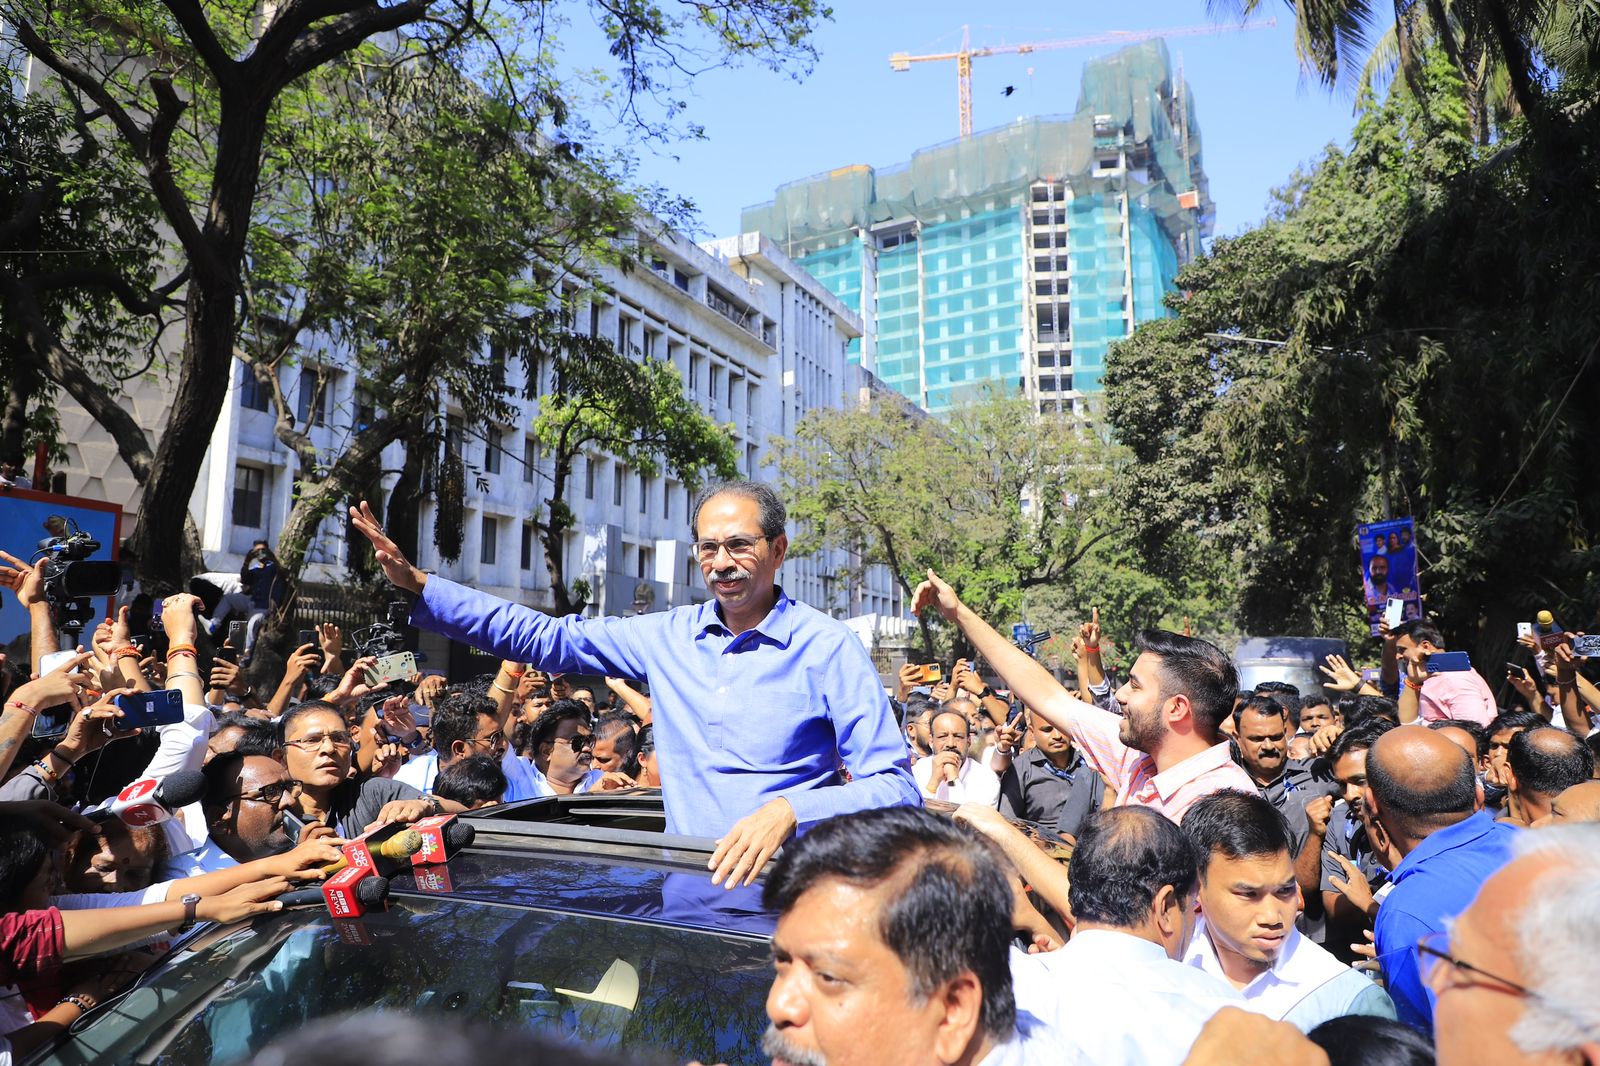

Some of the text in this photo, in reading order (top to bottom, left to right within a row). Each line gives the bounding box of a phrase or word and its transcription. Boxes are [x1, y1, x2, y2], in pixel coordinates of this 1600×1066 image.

[351, 845, 363, 867] TOD
[357, 849, 370, 867] INDI
[329, 889, 344, 915] NEWS
[336, 890, 350, 913] BBC
